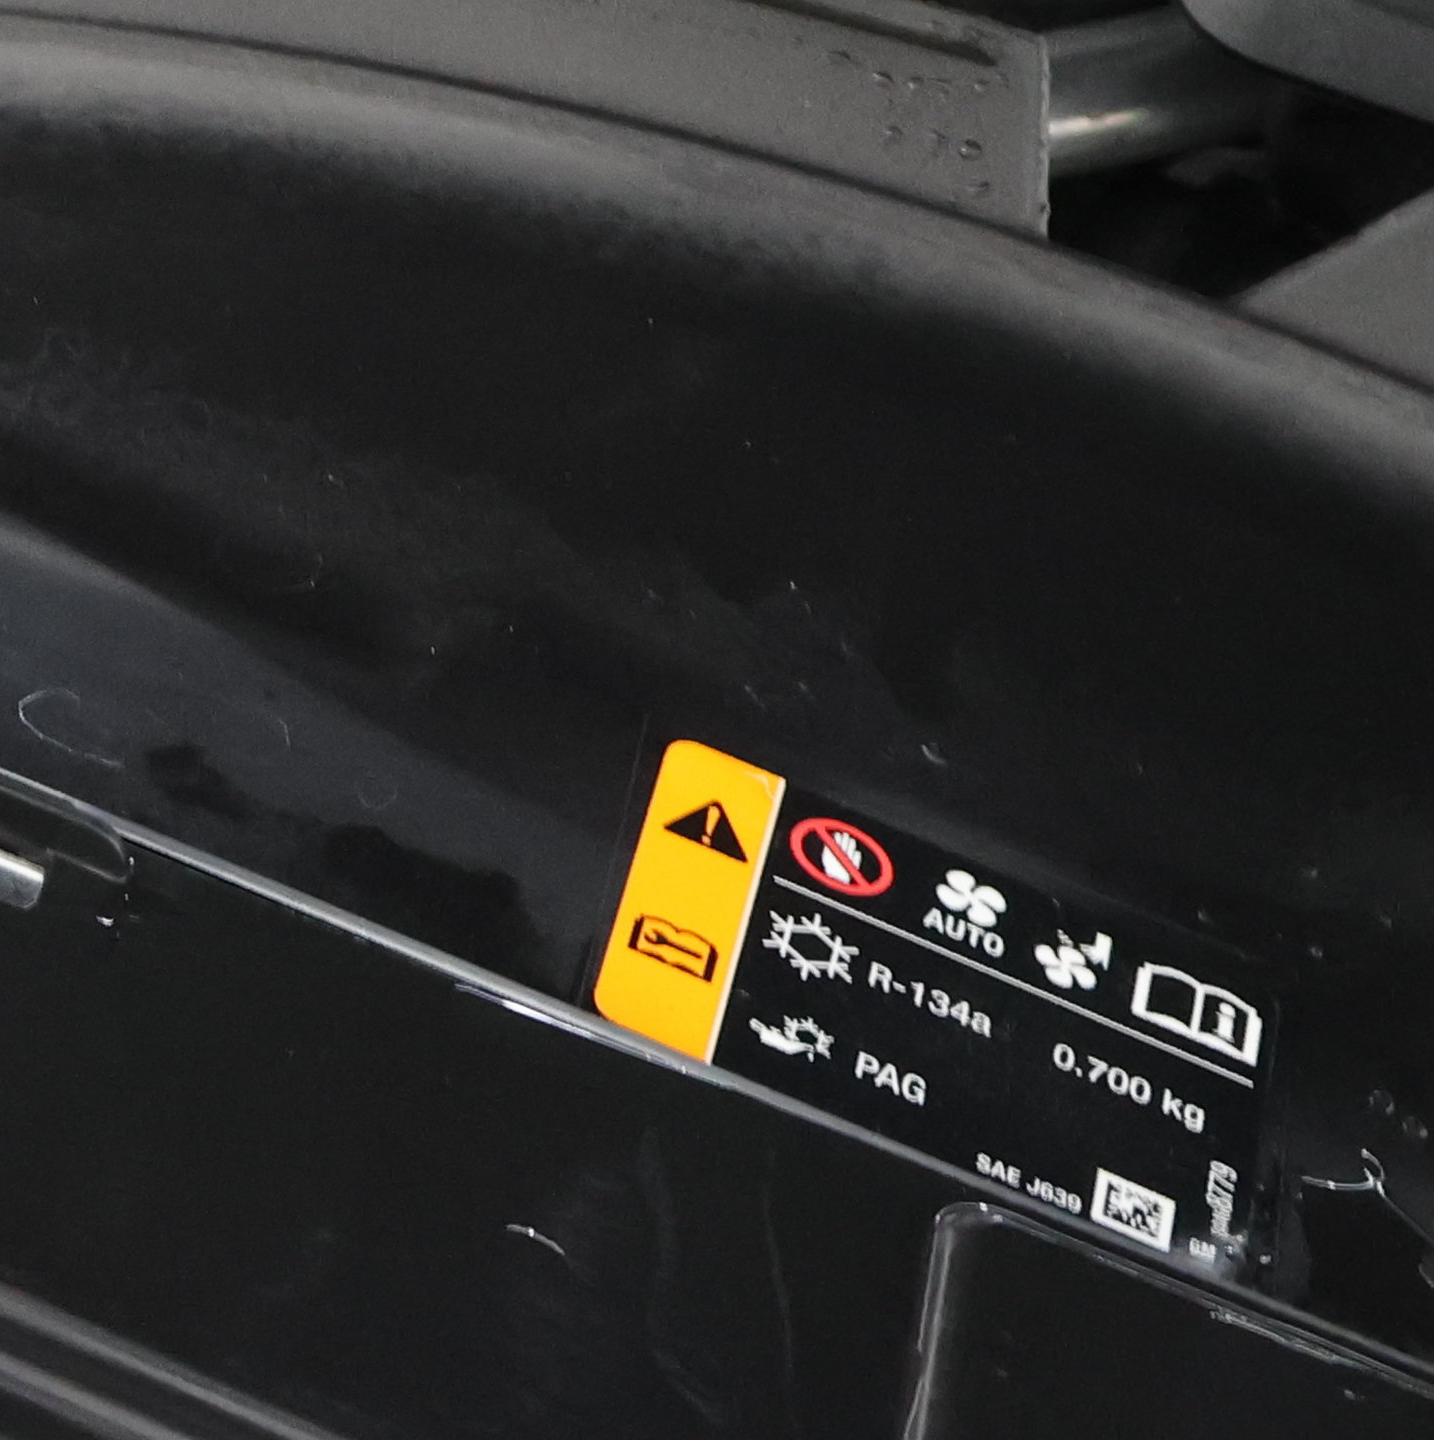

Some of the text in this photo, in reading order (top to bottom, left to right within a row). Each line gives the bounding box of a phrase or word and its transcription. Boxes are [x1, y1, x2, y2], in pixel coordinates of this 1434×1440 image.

[922, 907, 1005, 958] AUTO
[867, 961, 992, 1038] R-134a
[854, 1050, 928, 1106] PAG
[1052, 1042, 1206, 1134] 0.700 kg
[975, 1151, 1082, 1214] SAE J639
